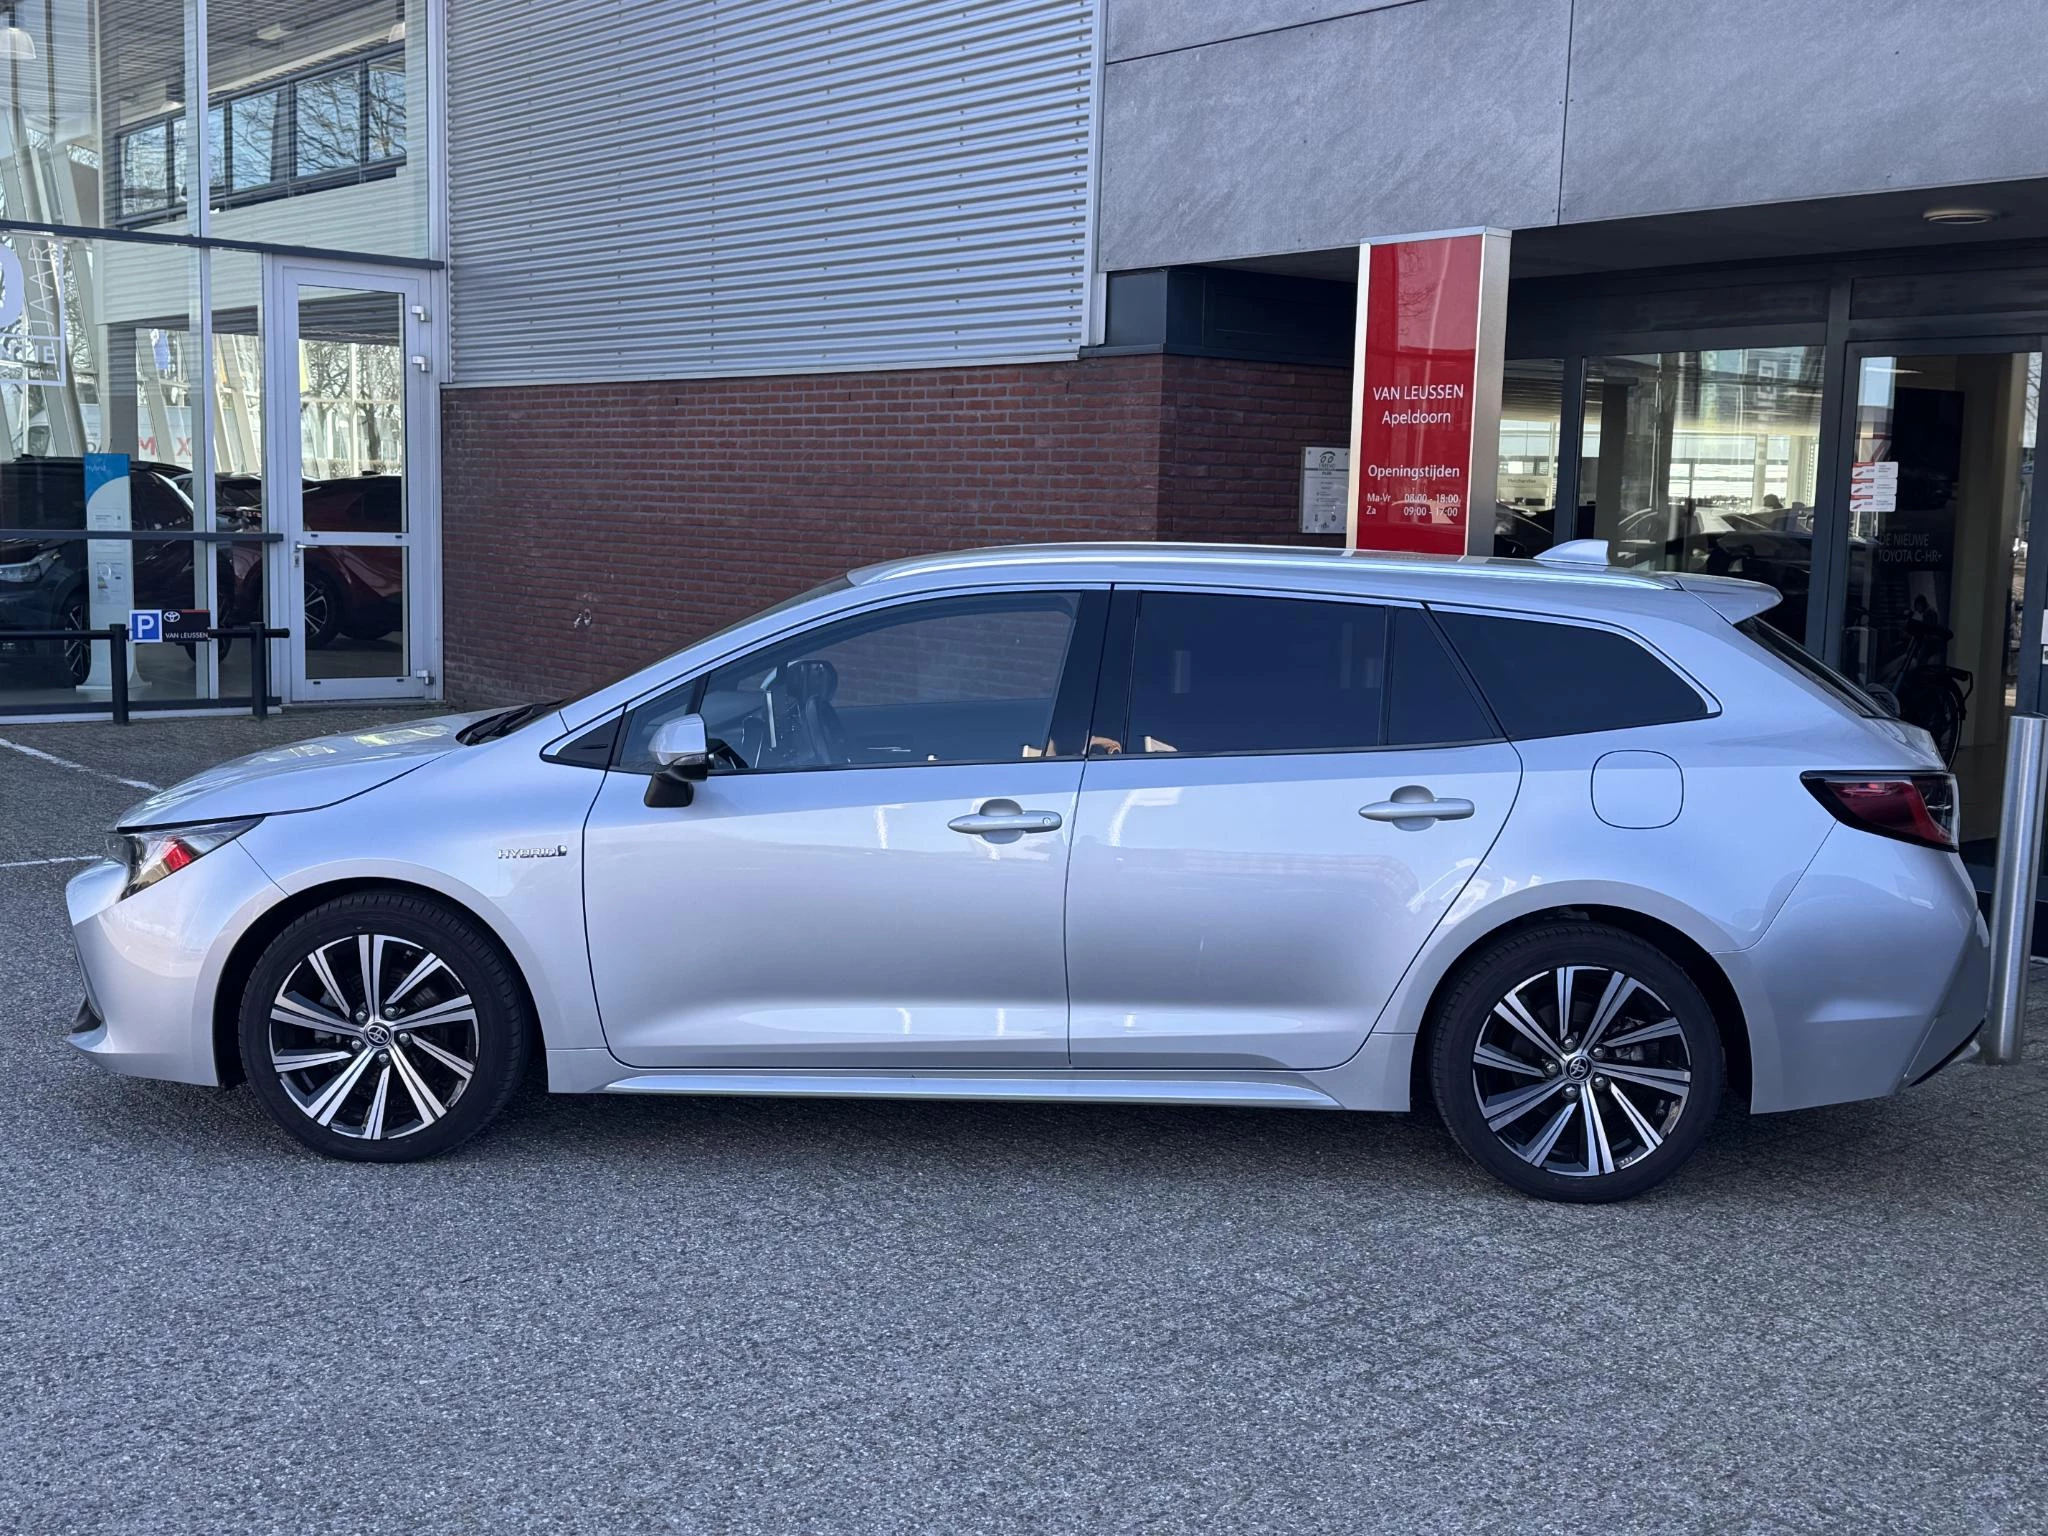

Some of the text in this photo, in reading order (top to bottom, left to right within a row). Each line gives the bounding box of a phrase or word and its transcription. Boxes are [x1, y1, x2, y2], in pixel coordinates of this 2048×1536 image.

[1373, 384, 1464, 401] VAN LEUSSEN
[1381, 409, 1451, 428] Apeldoorn
[1368, 464, 1460, 481] Openingstijden
[1366, 493, 1391, 503] Ma-Vr
[1404, 493, 1427, 503] 08:00
[1436, 494, 1459, 504] 18:00
[1366, 506, 1377, 515] Za
[1403, 506, 1427, 516] 09:00
[1894, 532, 1930, 547] NIEUWE
[1879, 549, 1912, 562] TOYOTA
[137, 615, 155, 638] P
[498, 848, 556, 859] HYBRID
